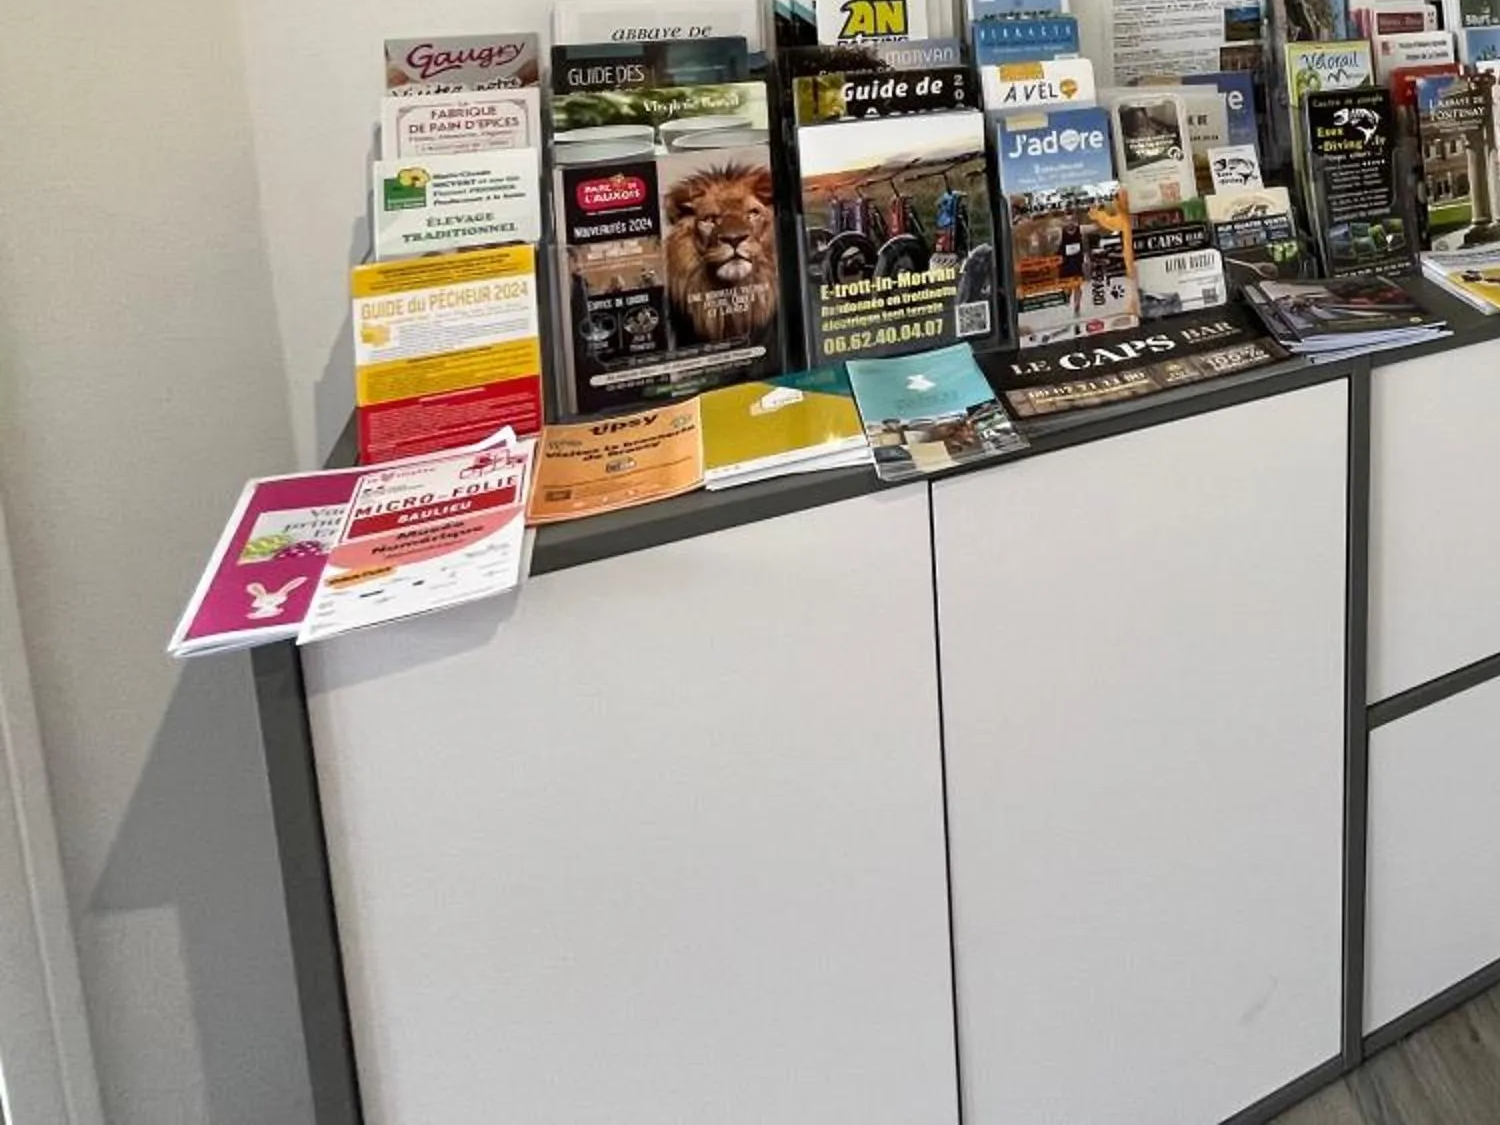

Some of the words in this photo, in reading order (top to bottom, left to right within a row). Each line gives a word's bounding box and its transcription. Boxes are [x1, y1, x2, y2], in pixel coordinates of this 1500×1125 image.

[405, 42, 527, 80] Gaugry
[567, 66, 614, 86] GUIDE
[615, 64, 646, 83] DES
[842, 77, 909, 102] Guide
[915, 76, 944, 97] de
[431, 106, 498, 120] FABRIQUE
[409, 124, 426, 134] DE
[429, 121, 461, 133] PAIN
[425, 211, 496, 228] ÉLEVAGE
[629, 217, 654, 233] 2024
[401, 222, 520, 244] TRADITIONNEL
[1147, 231, 1184, 250] CAPS
[819, 267, 957, 301] E-trott-in-Morvan
[361, 298, 404, 321] GUIDE
[407, 295, 427, 314] du
[494, 281, 529, 300] 2024
[1009, 359, 1051, 376] LE
[1057, 333, 1178, 372] CAPS
[1179, 321, 1234, 342] BAR
[589, 414, 659, 436] Upsy
[397, 500, 473, 524] SAULIEU
